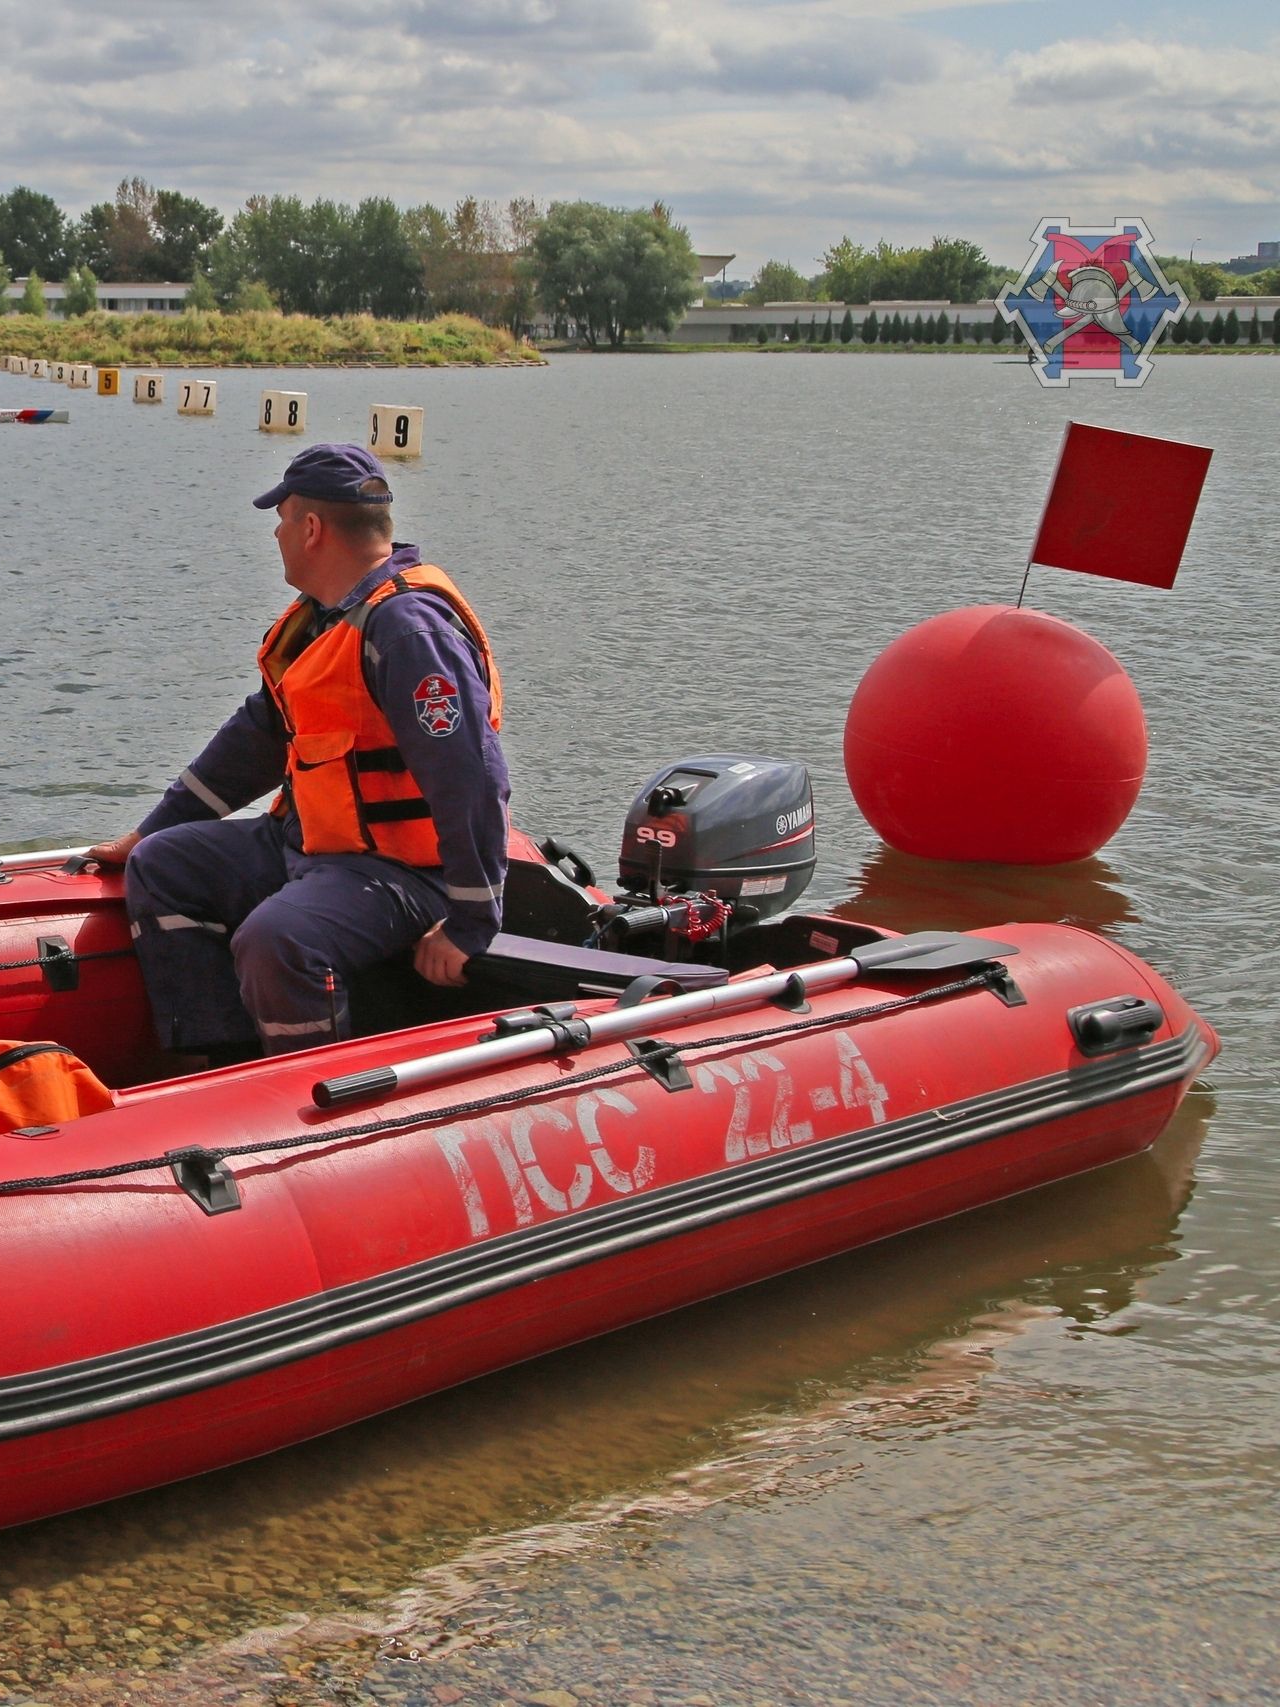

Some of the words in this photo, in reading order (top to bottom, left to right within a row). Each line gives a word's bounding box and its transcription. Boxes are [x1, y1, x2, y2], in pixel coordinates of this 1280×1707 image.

[33, 362, 40, 375] 2
[57, 366, 64, 380] 3
[82, 370, 87, 384] 4
[103, 373, 112, 390] 5
[147, 379, 156, 399] 6
[184, 386, 190, 407] 7
[203, 386, 210, 408] 7
[264, 398, 273, 425] 8
[288, 400, 298, 426] 8
[371, 413, 378, 446] 9
[394, 414, 410, 448] 9
[433, 1087, 656, 1238] ПСС
[696, 1031, 889, 1163] 22-4
